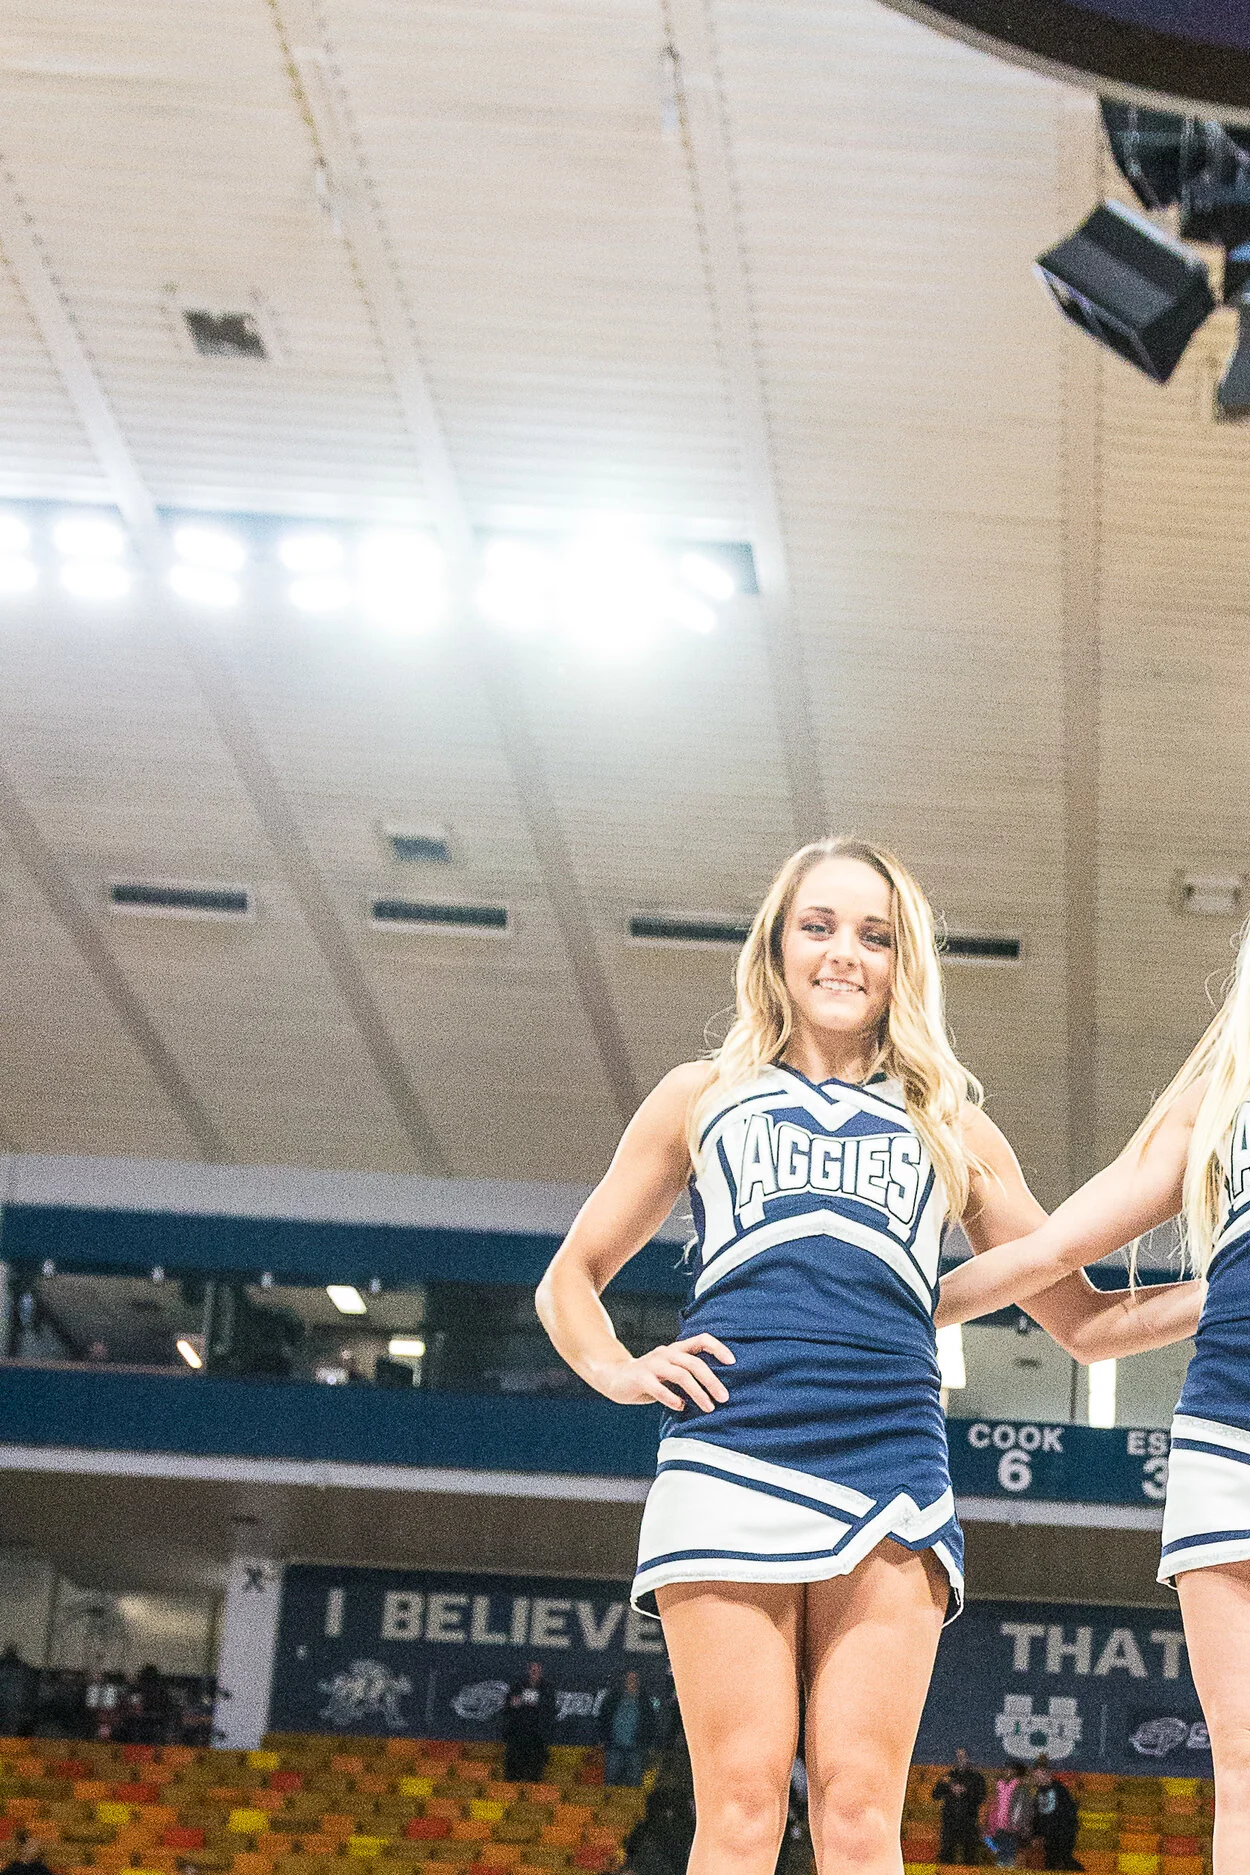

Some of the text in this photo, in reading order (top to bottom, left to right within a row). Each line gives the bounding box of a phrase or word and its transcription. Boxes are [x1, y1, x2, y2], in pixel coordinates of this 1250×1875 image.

[736, 1113, 922, 1227] AGGIES
[967, 1423, 1064, 1452] COOK
[998, 1449, 1032, 1493] 6
[241, 1563, 265, 1592] X
[324, 1587, 666, 1653] I BELIEVE
[1000, 1622, 1186, 1680] THAT
